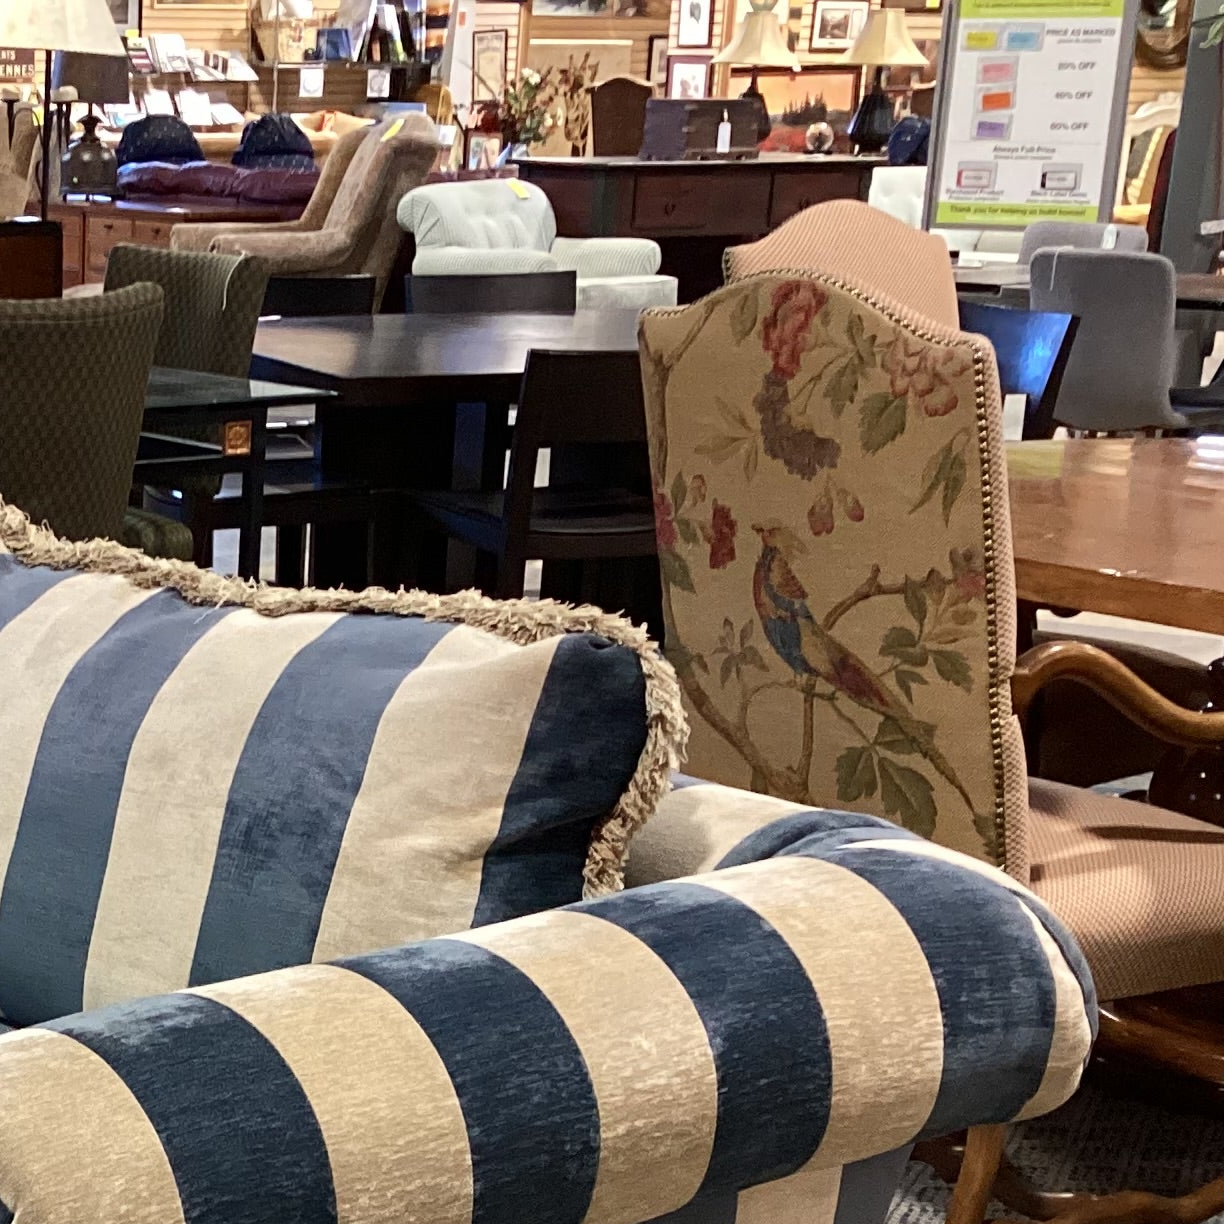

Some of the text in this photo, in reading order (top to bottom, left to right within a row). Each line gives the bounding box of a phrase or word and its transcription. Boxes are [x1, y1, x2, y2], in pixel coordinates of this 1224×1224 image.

[1046, 27, 1116, 36] PRICE AS MARKED
[1078, 62, 1096, 70] OFF
[1075, 91, 1093, 99] OFF
[1070, 122, 1089, 130] OFF
[993, 145, 1019, 153] Always
